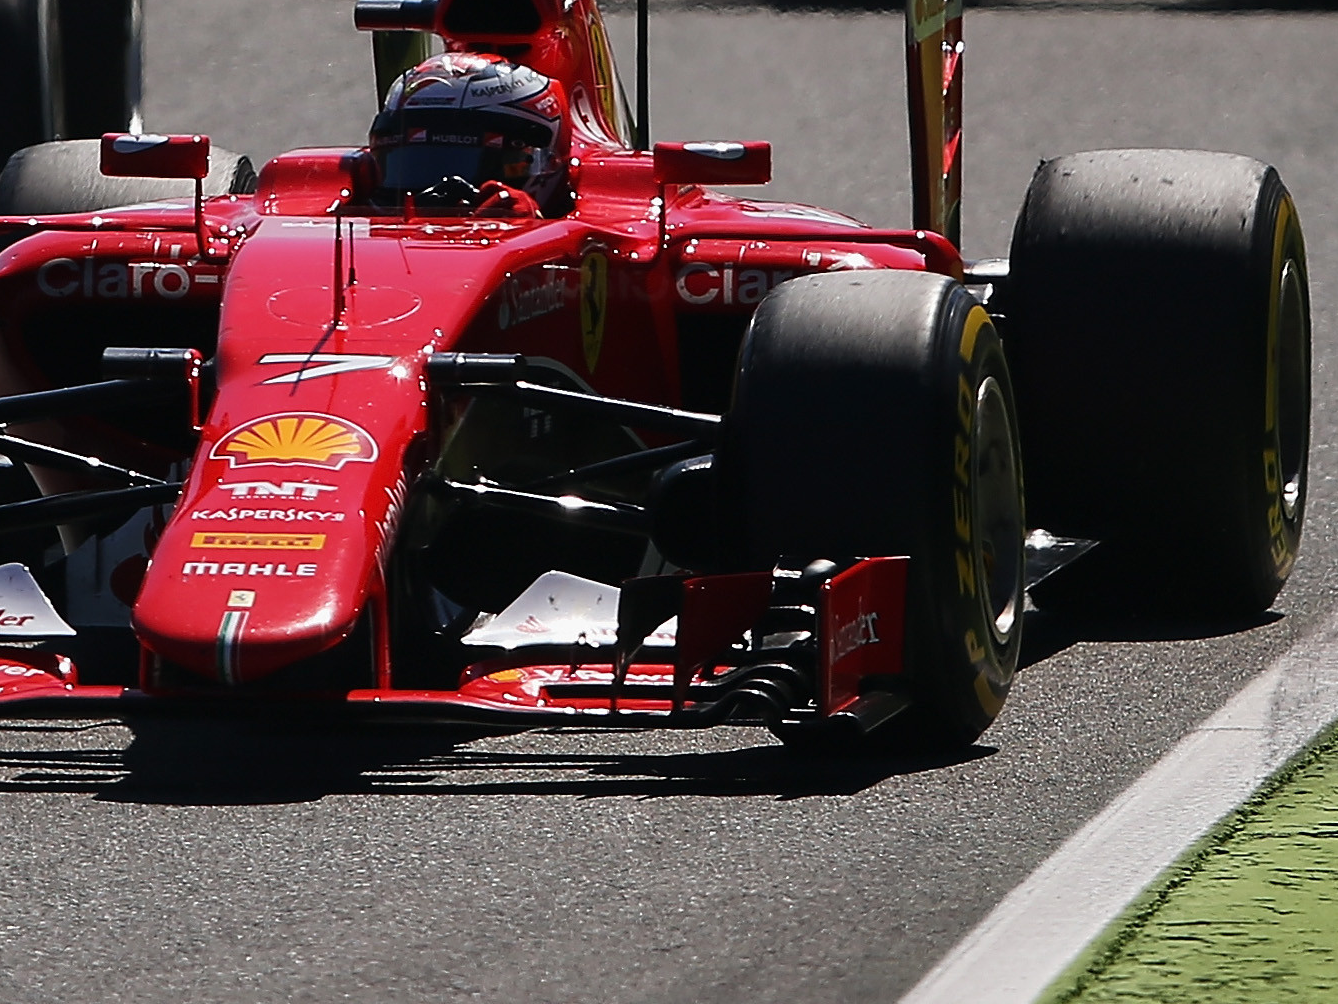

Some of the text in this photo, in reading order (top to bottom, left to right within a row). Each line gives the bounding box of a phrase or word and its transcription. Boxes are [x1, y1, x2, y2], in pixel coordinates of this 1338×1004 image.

[431, 134, 479, 145] HUBLOT
[256, 353, 395, 386] 7
[218, 481, 339, 498] TNT
[191, 507, 332, 522] KASPERSKY
[202, 536, 313, 547] PIRELLI
[182, 562, 318, 577] MAHLE
